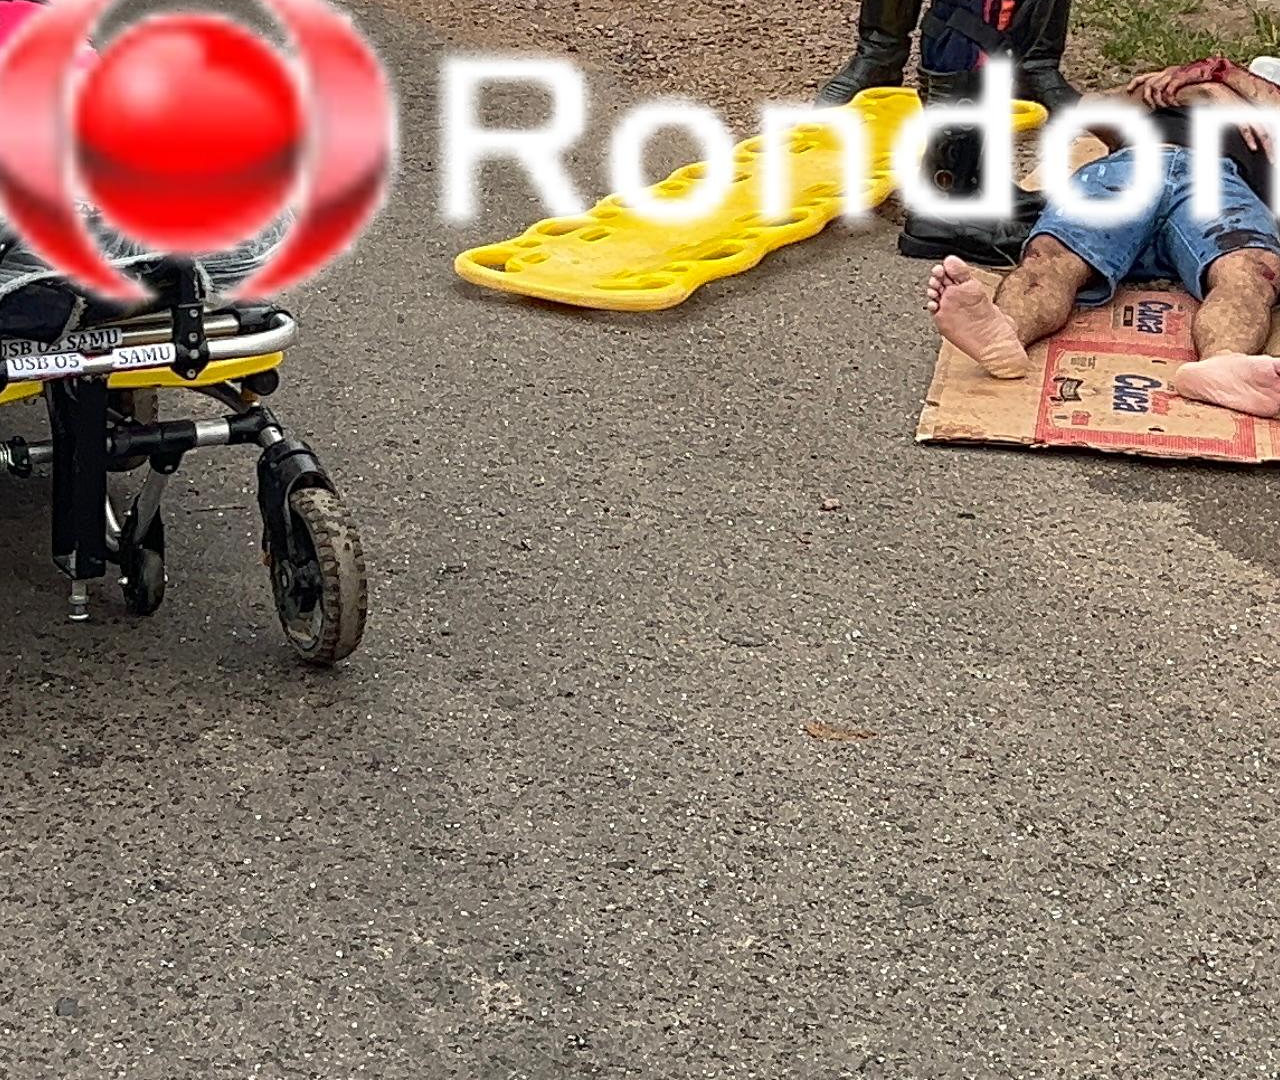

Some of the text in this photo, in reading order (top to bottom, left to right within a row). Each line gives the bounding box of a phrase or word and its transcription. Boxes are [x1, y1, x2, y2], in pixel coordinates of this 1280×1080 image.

[66, 329, 119, 351] SAMU
[13, 357, 50, 371] USB
[118, 346, 171, 366] SAMU
